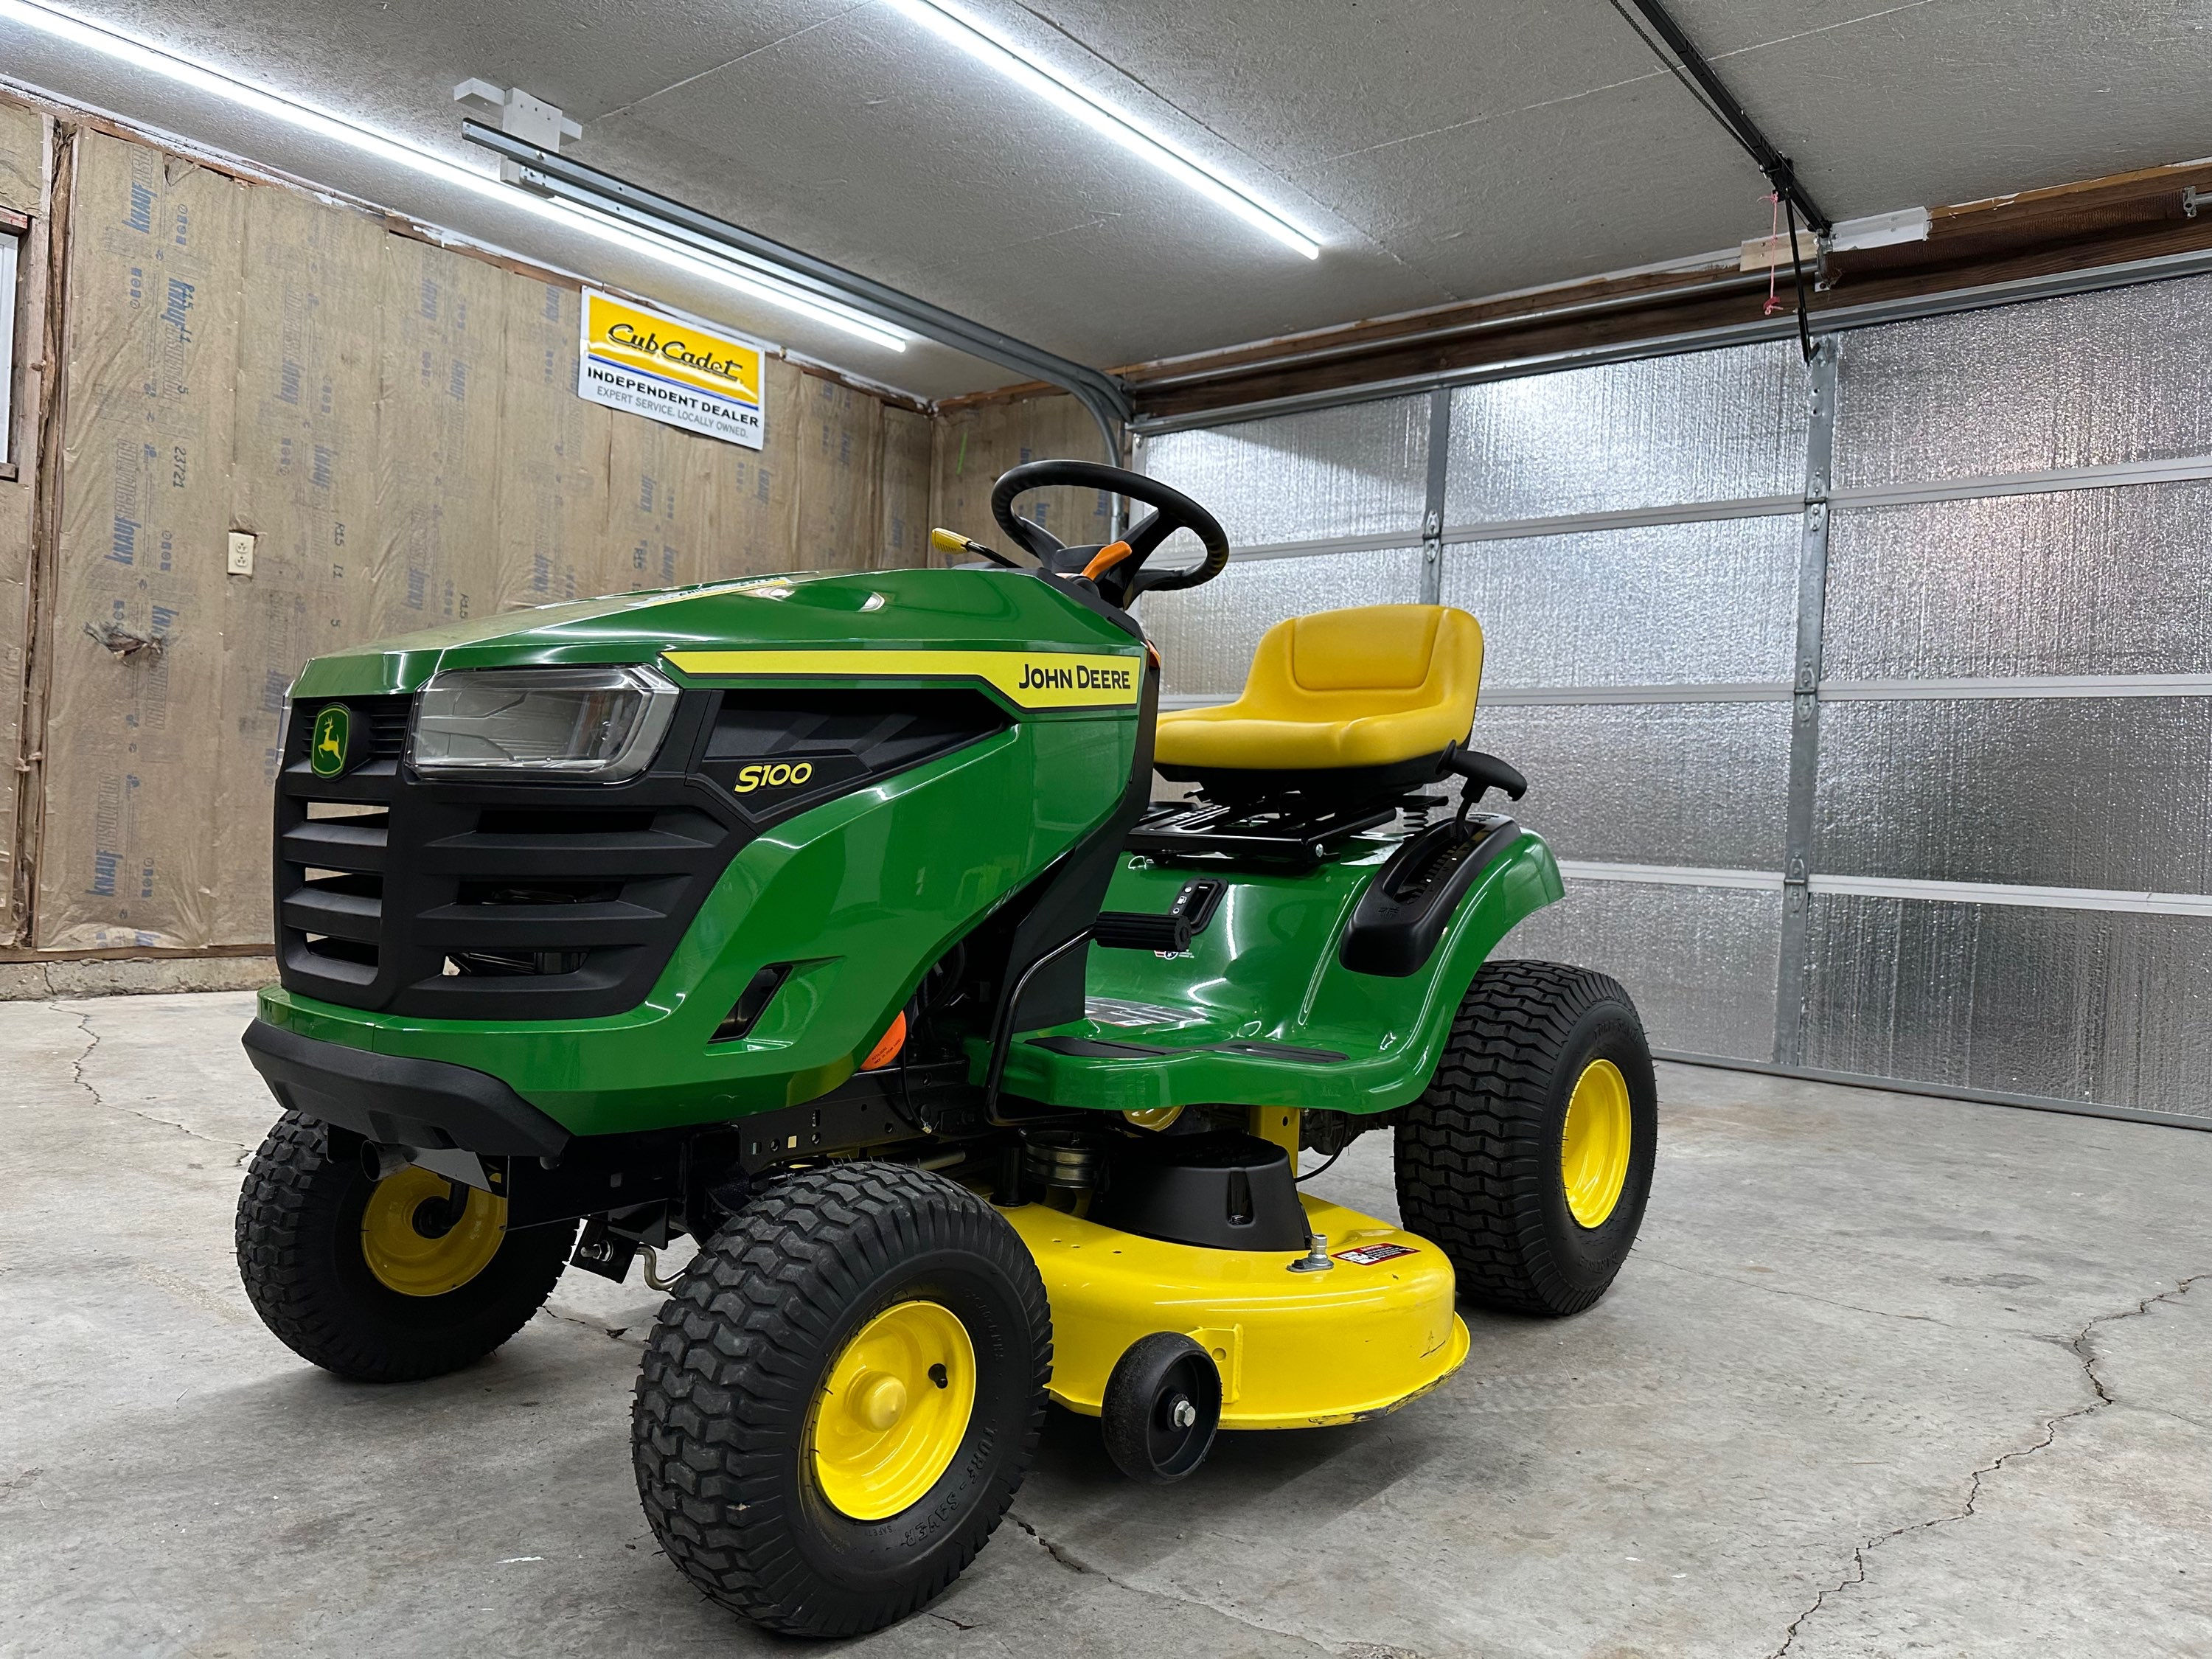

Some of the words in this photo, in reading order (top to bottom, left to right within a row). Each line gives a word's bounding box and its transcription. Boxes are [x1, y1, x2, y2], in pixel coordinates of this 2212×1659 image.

[122, 181, 157, 234] KNAUF
[608, 324, 658, 354] Cub
[661, 341, 743, 380] Cadet
[588, 367, 698, 408] INDEPENDENT
[701, 402, 759, 428] DEALER
[597, 386, 633, 404] EXPERT
[635, 397, 675, 416] SERVICE.
[678, 410, 713, 428] LOCALLY
[716, 422, 748, 439] OWNED.
[173, 445, 187, 489] 23721
[103, 515, 142, 566] KNAUF
[1019, 664, 1073, 689] JOHN
[1077, 665, 1130, 689] DEERE
[734, 762, 813, 793] S100
[85, 849, 123, 898] KNAUF
